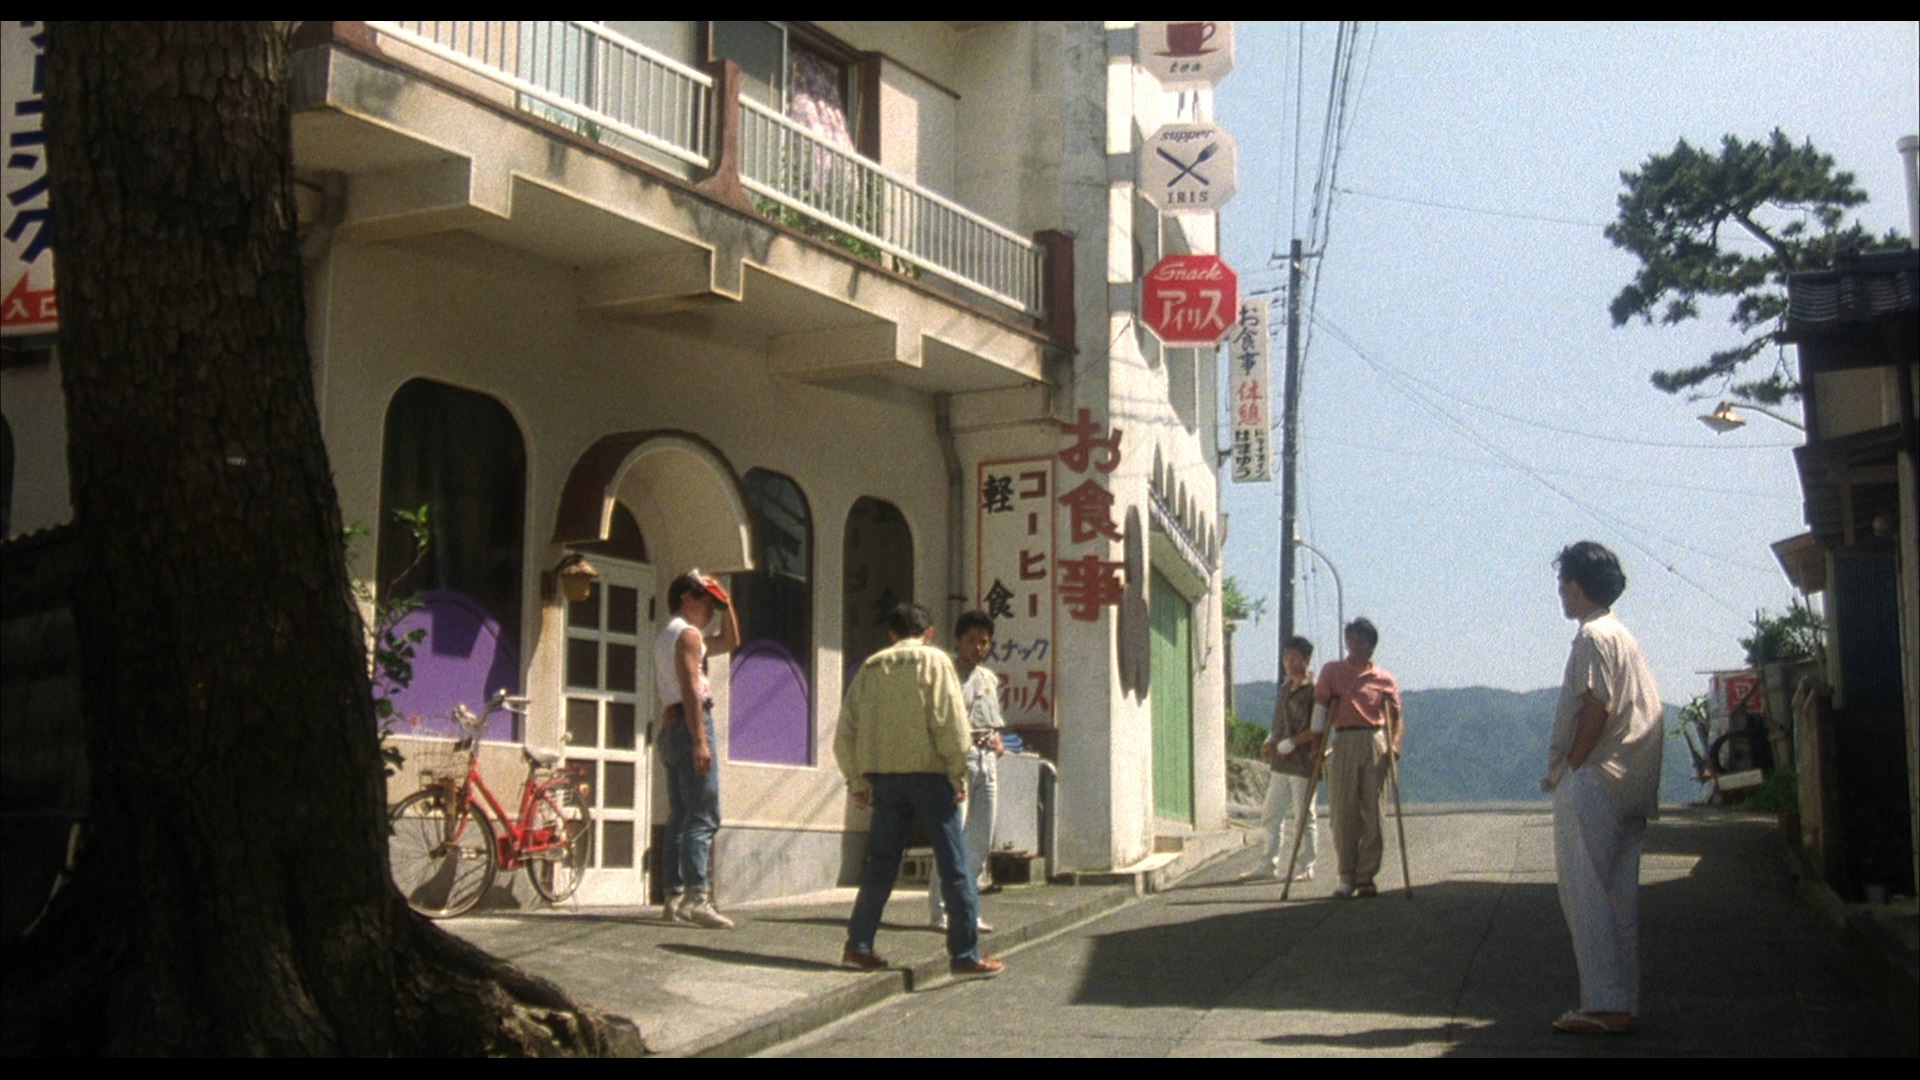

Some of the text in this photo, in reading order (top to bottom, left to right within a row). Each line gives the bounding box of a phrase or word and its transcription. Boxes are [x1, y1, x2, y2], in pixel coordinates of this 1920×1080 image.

[1168, 61, 1202, 73] tea
[1159, 128, 1216, 143] supper
[1166, 190, 1210, 204] IRIS
[1153, 262, 1224, 282] Snack
[4, 296, 58, 318] 入口
[1232, 303, 1260, 377] お食事
[1057, 407, 1126, 623] お食事
[1018, 470, 1048, 618] コーヒー
